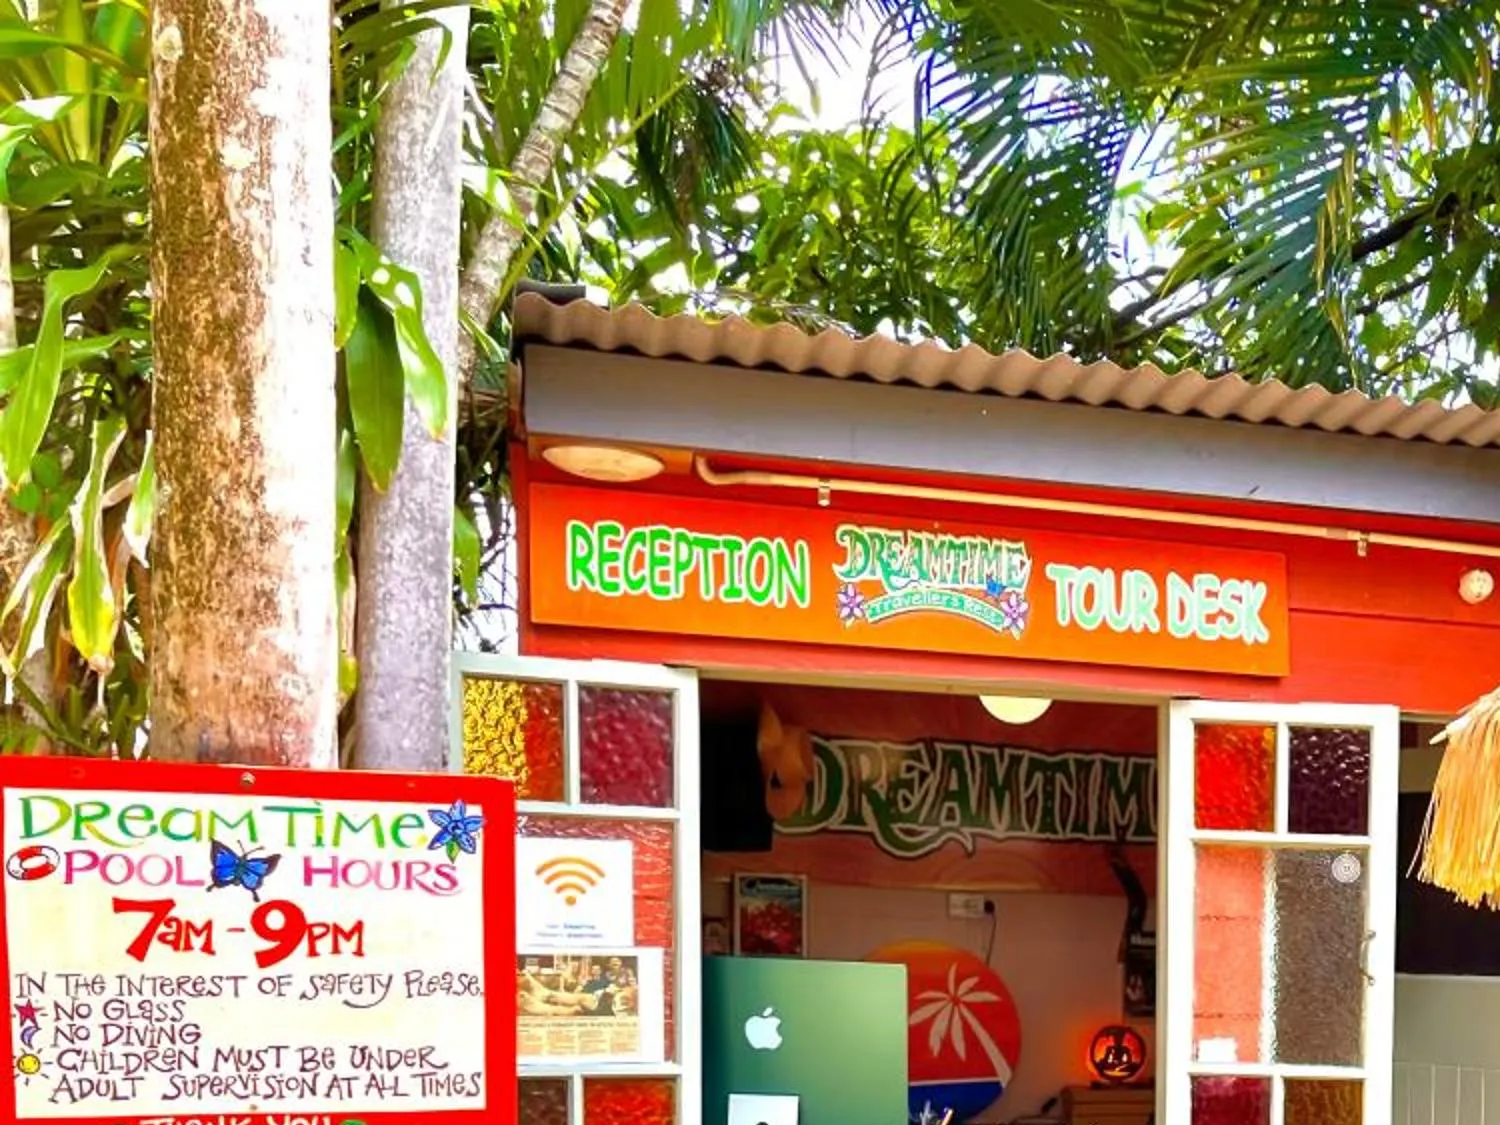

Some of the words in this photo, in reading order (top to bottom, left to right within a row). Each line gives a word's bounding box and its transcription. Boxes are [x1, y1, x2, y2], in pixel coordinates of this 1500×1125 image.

[566, 520, 811, 608] RECEPTION
[833, 524, 1032, 595] DREAMTIME
[1046, 563, 1160, 632] TOUR
[1166, 571, 1269, 644] DESK
[774, 734, 1156, 858] DREAMTIM
[63, 849, 205, 887] POOL
[303, 855, 462, 897] HOURS
[250, 899, 365, 969] 9PM
[15, 972, 47, 999] IN
[257, 974, 293, 997] OF
[53, 998, 92, 1022] NO
[50, 1023, 91, 1047] NO
[212, 1044, 290, 1073] MUST
[49, 1074, 145, 1105] ADULT
[324, 1074, 360, 1100] AT
[364, 1073, 410, 1099] ALL
